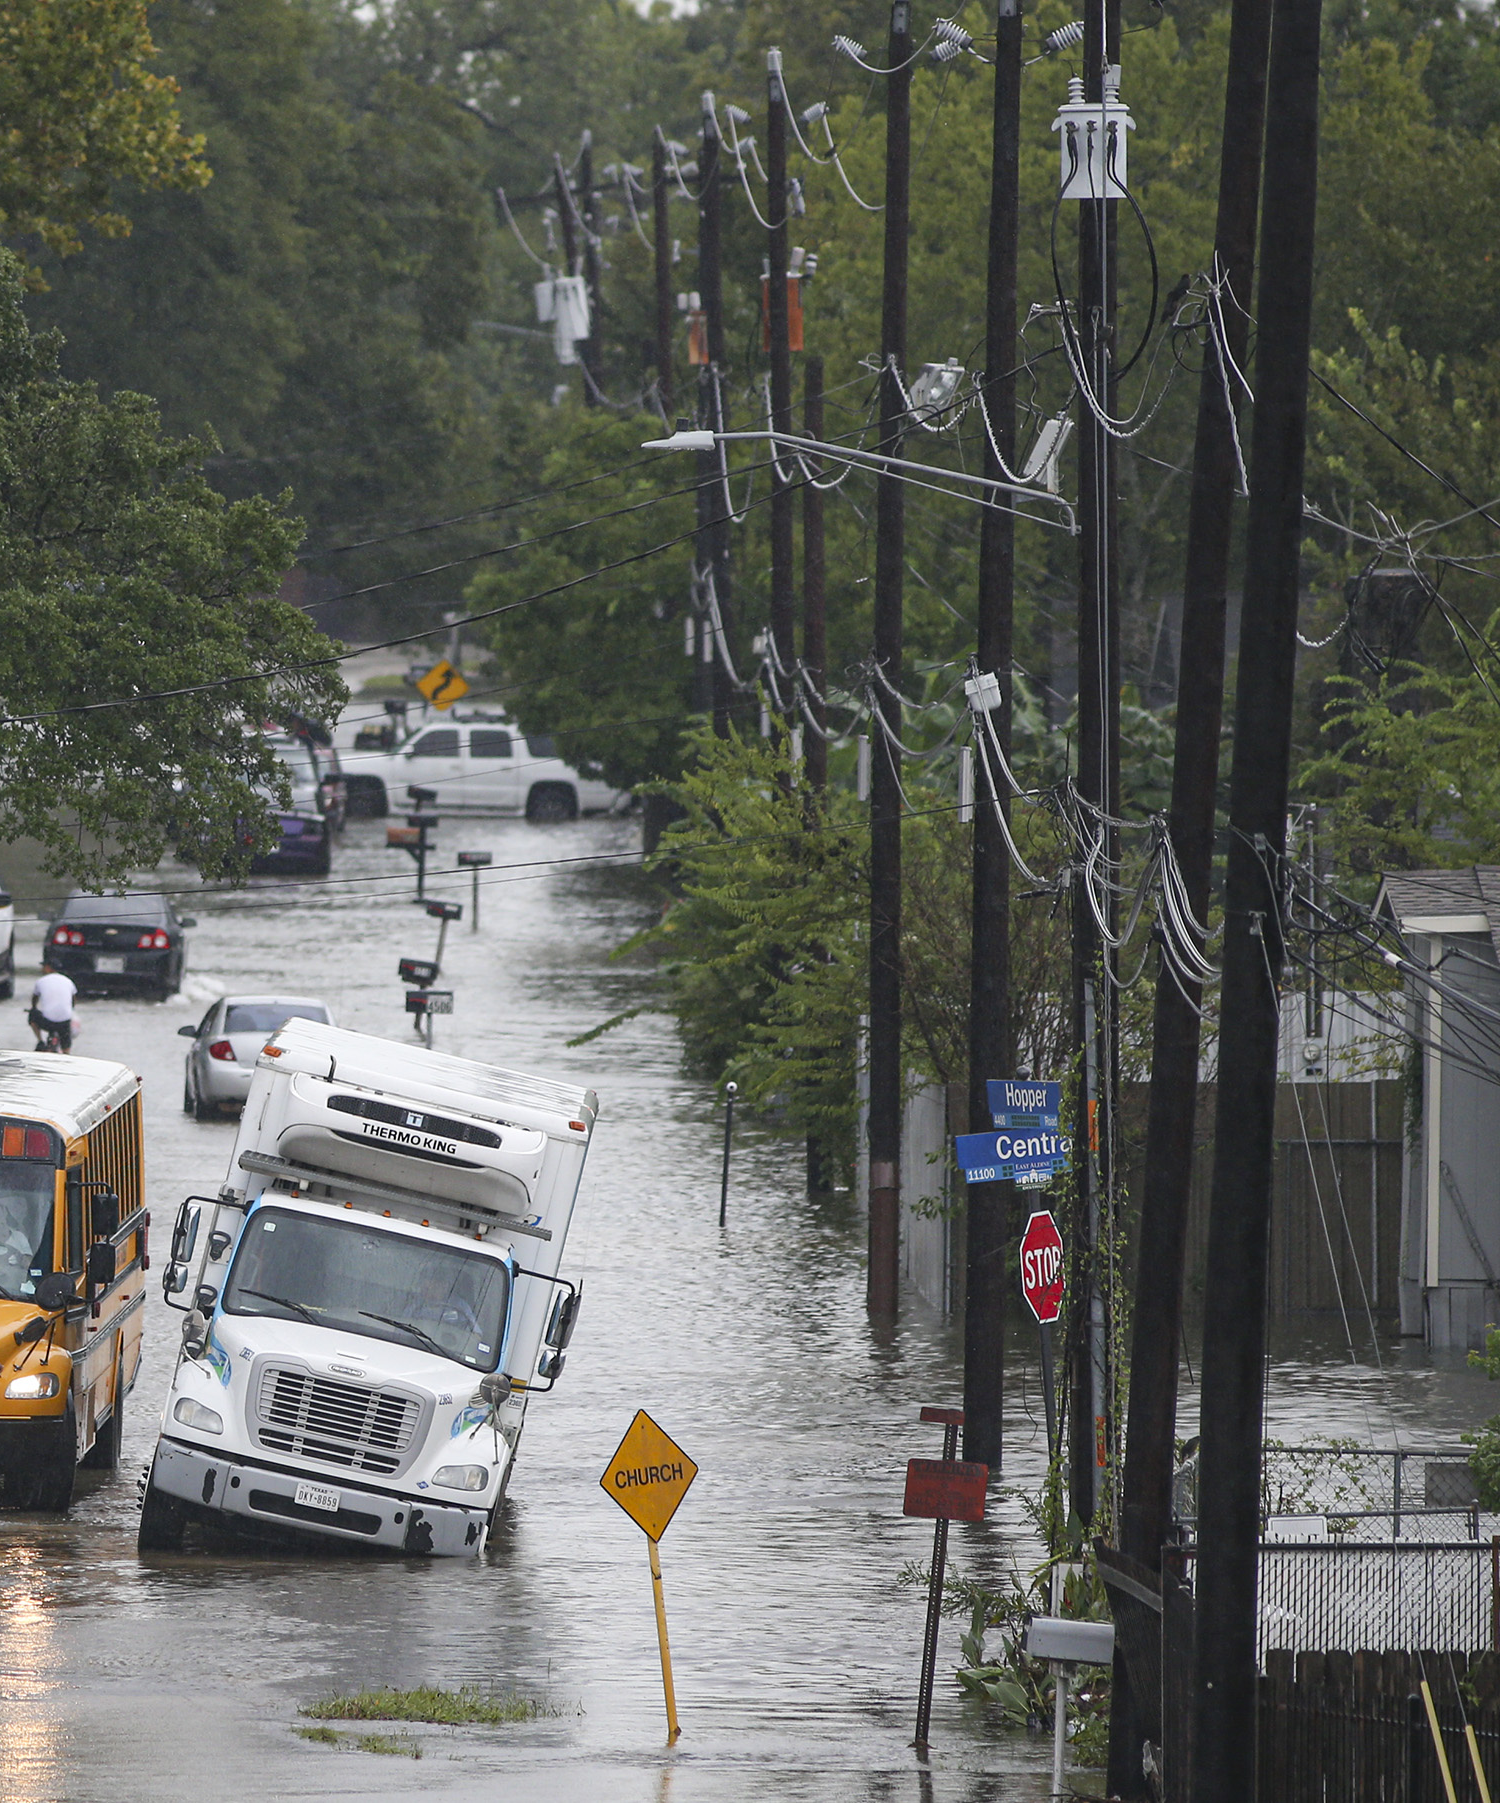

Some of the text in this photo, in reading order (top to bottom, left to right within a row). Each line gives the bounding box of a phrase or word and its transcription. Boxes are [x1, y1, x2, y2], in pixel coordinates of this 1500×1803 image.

[1005, 1083, 1047, 1112] Hopper
[994, 1114, 1057, 1126] 4400 Road
[361, 1122, 457, 1155] THERMO KING
[996, 1131, 1073, 1160] Centra
[968, 1167, 995, 1182] 11100
[1025, 1245, 1062, 1291] STOP
[615, 1462, 684, 1489] CHURCH
[311, 1486, 328, 1494] TEXAS
